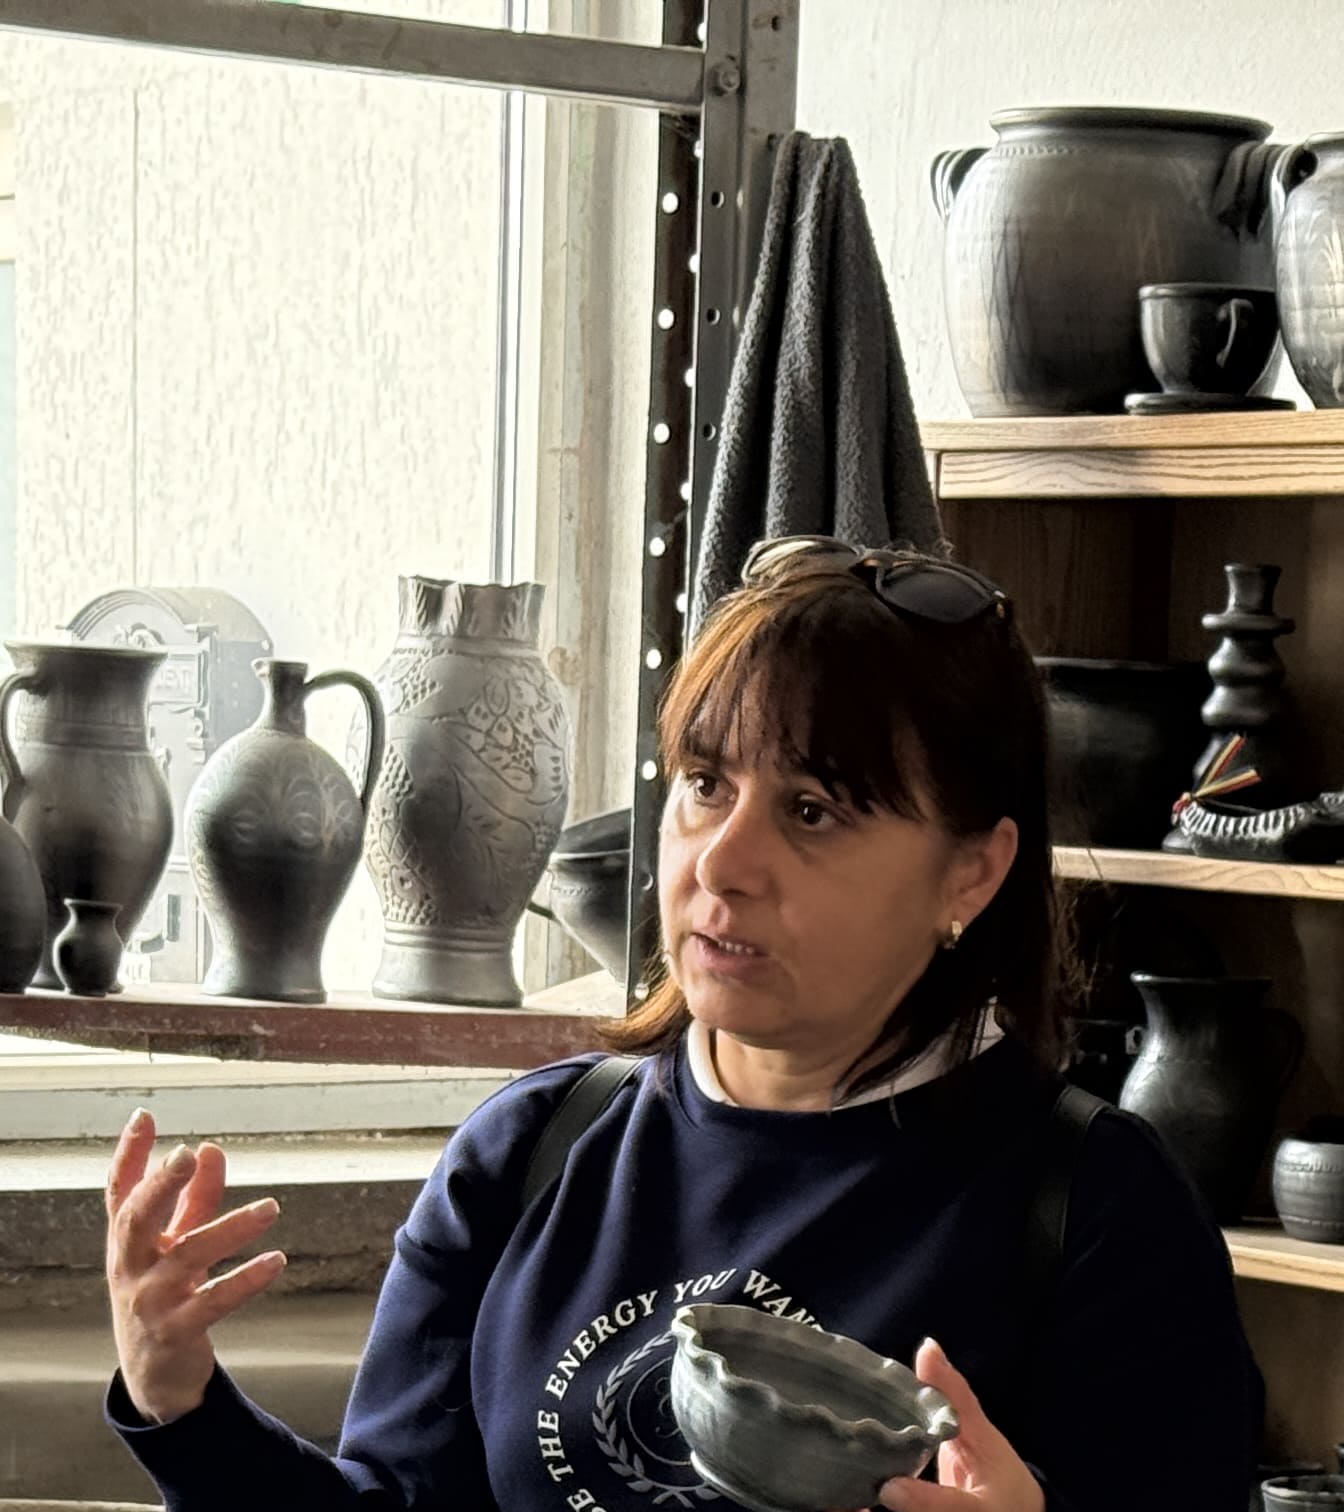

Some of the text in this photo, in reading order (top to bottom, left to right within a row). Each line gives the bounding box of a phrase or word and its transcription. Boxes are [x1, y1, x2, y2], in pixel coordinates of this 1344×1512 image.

[673, 1268, 737, 1304] YOU
[545, 1290, 658, 1401] ENERGY
[537, 1409, 574, 1482] THE
